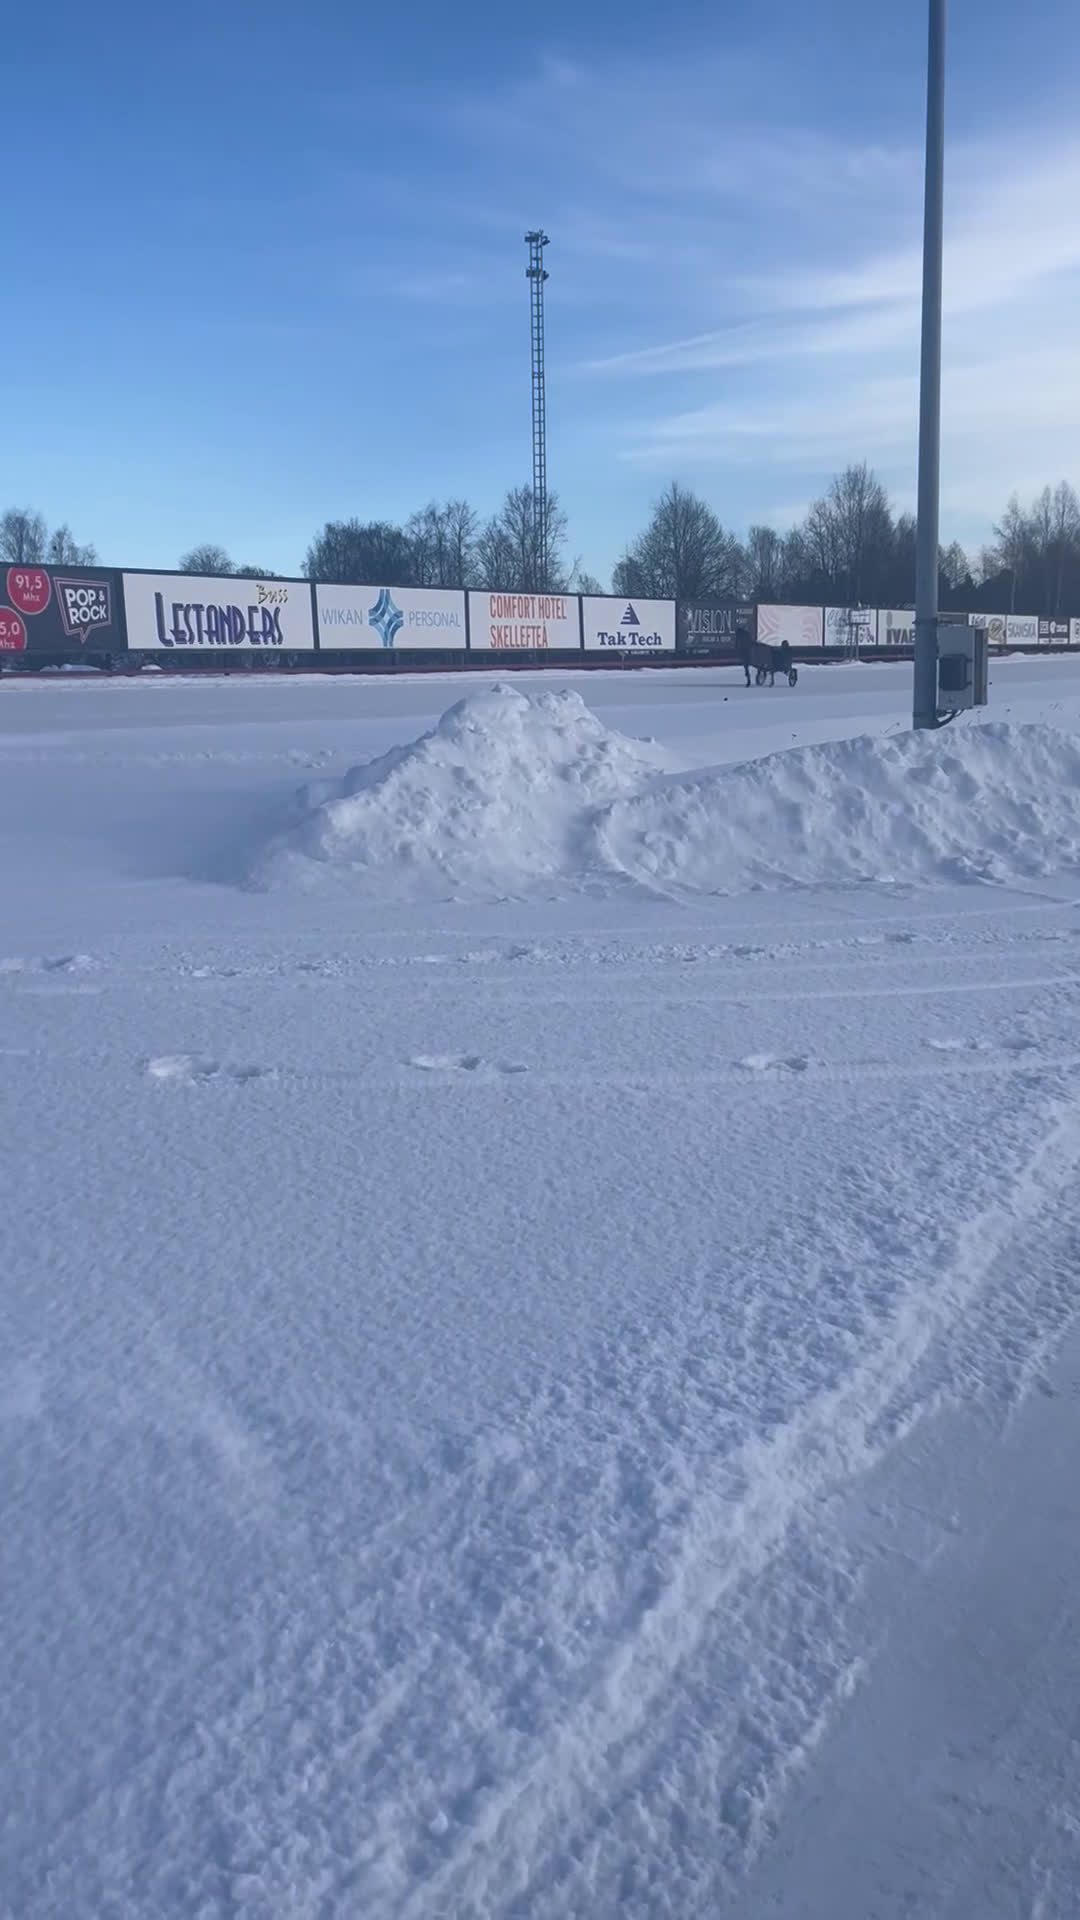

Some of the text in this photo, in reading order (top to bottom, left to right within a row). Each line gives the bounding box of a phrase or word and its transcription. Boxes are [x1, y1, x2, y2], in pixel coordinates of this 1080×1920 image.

[15, 575, 42, 591] 91,5
[23, 593, 40, 601] Mhz
[64, 588, 105, 607] POP &
[490, 594, 567, 620] COMFORT HOTEL
[68, 605, 107, 625] ROCK
[154, 592, 283, 647] LESTANDERS
[321, 609, 461, 628] WIKAN PERSONAL
[686, 608, 735, 634] VISION
[490, 621, 548, 648] SKELLEFTEÅ
